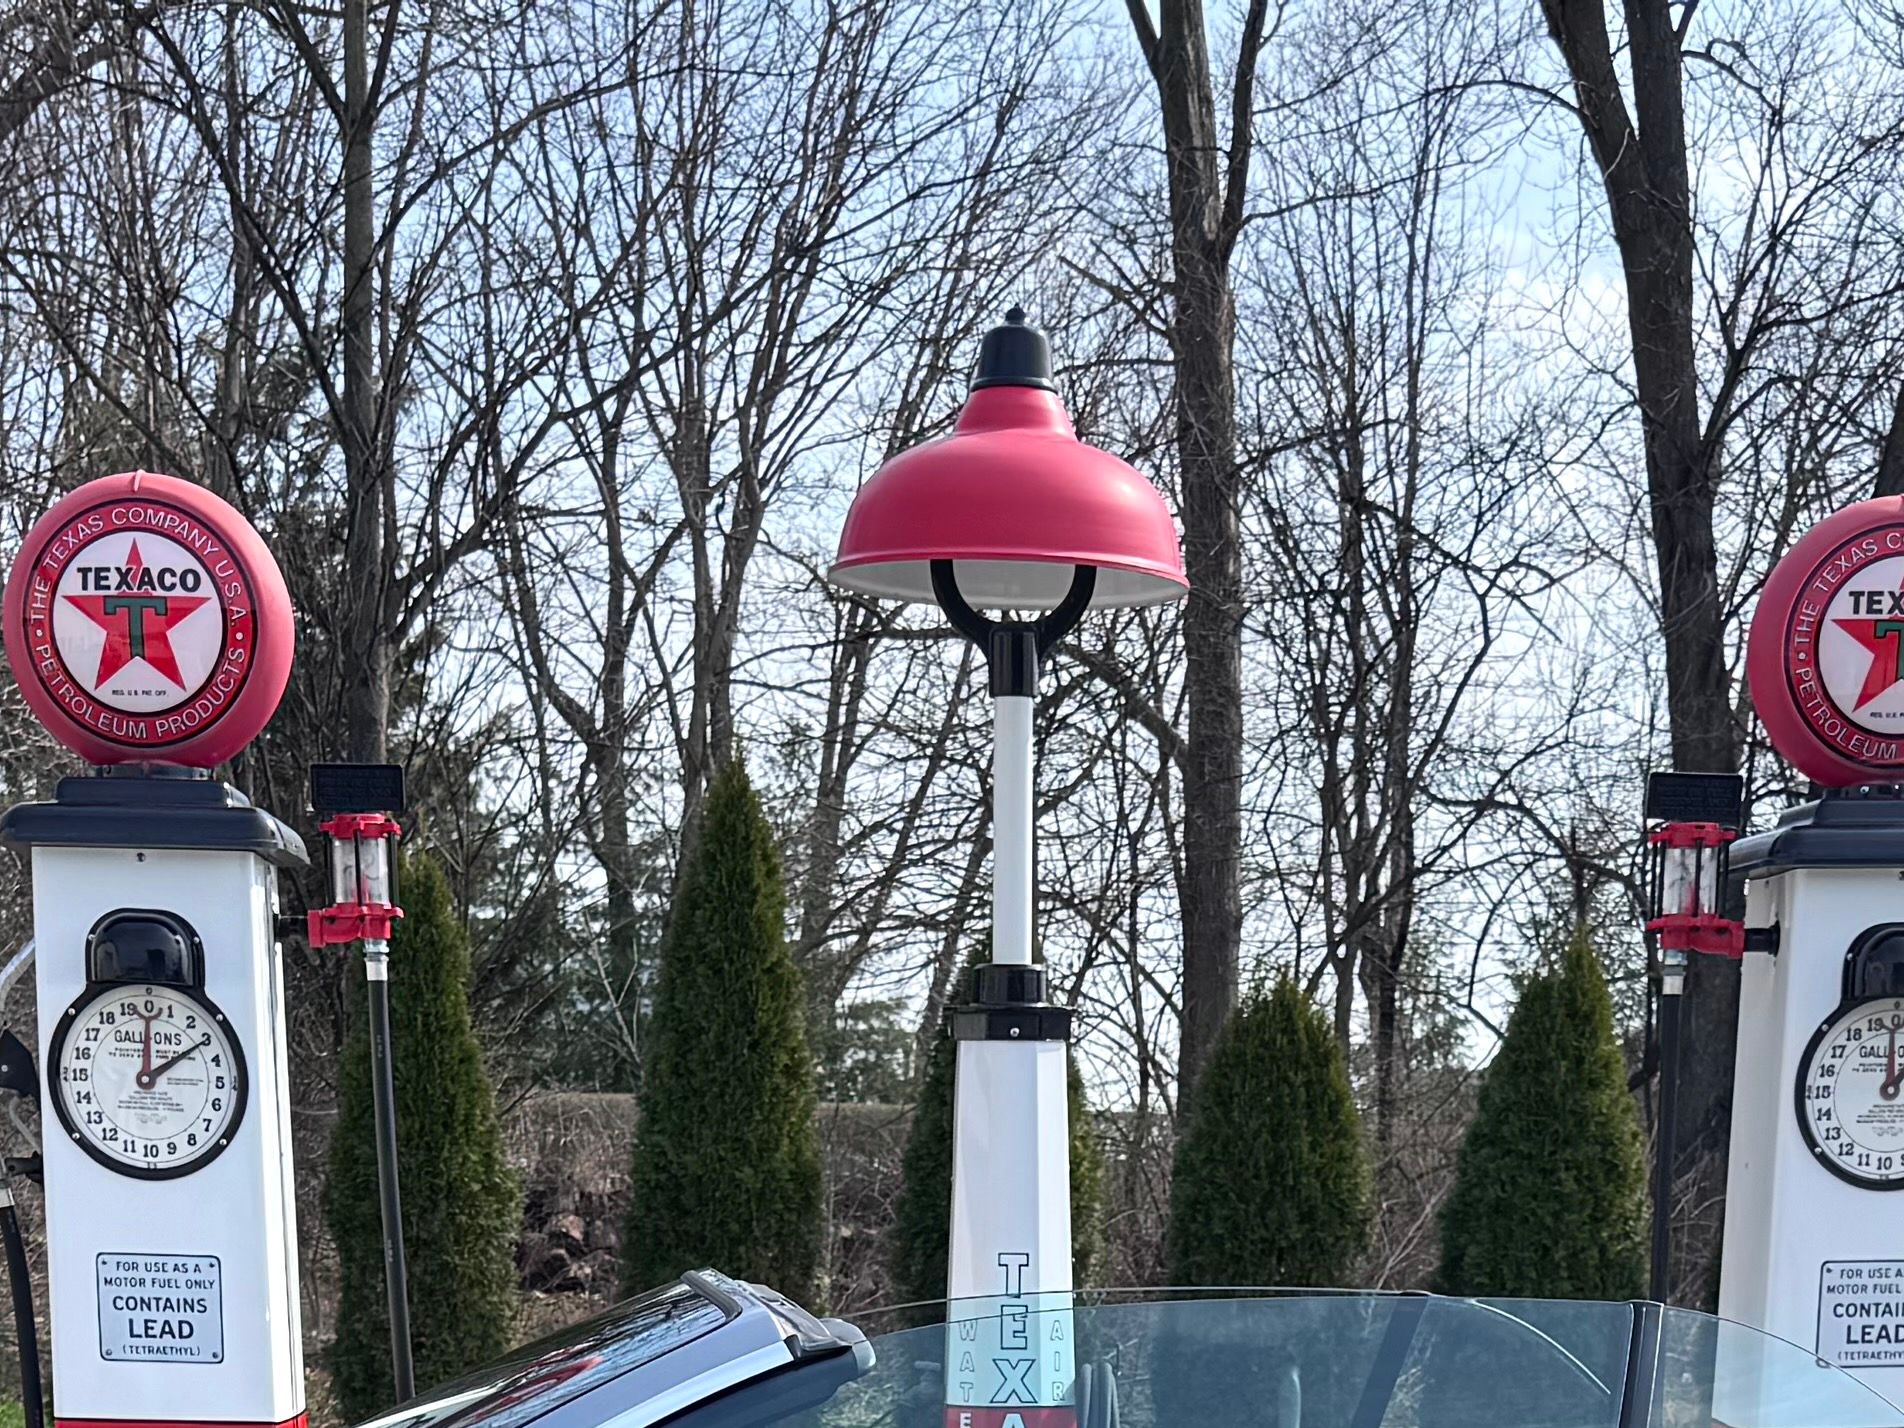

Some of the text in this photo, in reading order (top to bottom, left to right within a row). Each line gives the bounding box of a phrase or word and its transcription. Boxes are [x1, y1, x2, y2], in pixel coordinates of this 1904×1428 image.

[30, 576, 51, 624] THE
[44, 515, 103, 570] TEXAS
[111, 507, 219, 555] COMPANY
[77, 566, 202, 592] TEXACO
[1794, 601, 1820, 645] THE
[1812, 539, 1878, 591] TEXAS
[34, 645, 246, 739] PETROLEUM PRODUCTS
[1794, 669, 1897, 760] PETROLEUM
[120, 1002, 136, 1016] 19
[144, 1000, 154, 1013] 0
[167, 1005, 173, 1018] 1
[100, 1012, 115, 1024] 18
[186, 1016, 196, 1029] 2
[1892, 1015, 1901, 1029] 0
[1867, 1019, 1883, 1031] 19
[85, 1029, 100, 1041] 17
[202, 1033, 211, 1046] 3
[1846, 1029, 1861, 1041] 18
[75, 1048, 90, 1060] 16
[1831, 1046, 1846, 1058] 17
[211, 1055, 221, 1067] 4
[72, 1069, 88, 1081] 15
[1819, 1065, 1835, 1077] 16
[215, 1077, 225, 1090] 5
[1815, 1085, 1831, 1098] 15
[76, 1092, 91, 1104] 14
[212, 1099, 221, 1111] 6
[86, 1112, 103, 1124] 13
[1817, 1109, 1832, 1121] 14
[203, 1119, 212, 1132] 7
[102, 1129, 118, 1141] 12
[188, 1134, 196, 1145] 8
[1825, 1128, 1841, 1140] 13
[123, 1140, 136, 1152] 11
[143, 1145, 158, 1158] 10
[167, 1143, 176, 1155] 9
[1838, 1143, 1854, 1155] 12
[1857, 1155, 1870, 1167] 11
[1877, 1157, 1892, 1170] 10
[116, 1261, 201, 1273] FOR USE AS A
[1840, 1269, 1862, 1279] FOR
[1868, 1268, 1891, 1278] USE
[104, 1277, 215, 1289] MOTOR FUEL ONLY
[1827, 1285, 1868, 1294] MOTOR
[1873, 1284, 1901, 1294] FUEL
[113, 1296, 207, 1313] CONTAINS
[128, 1318, 194, 1339] LEAD
[1050, 1319, 1066, 1402] AIR
